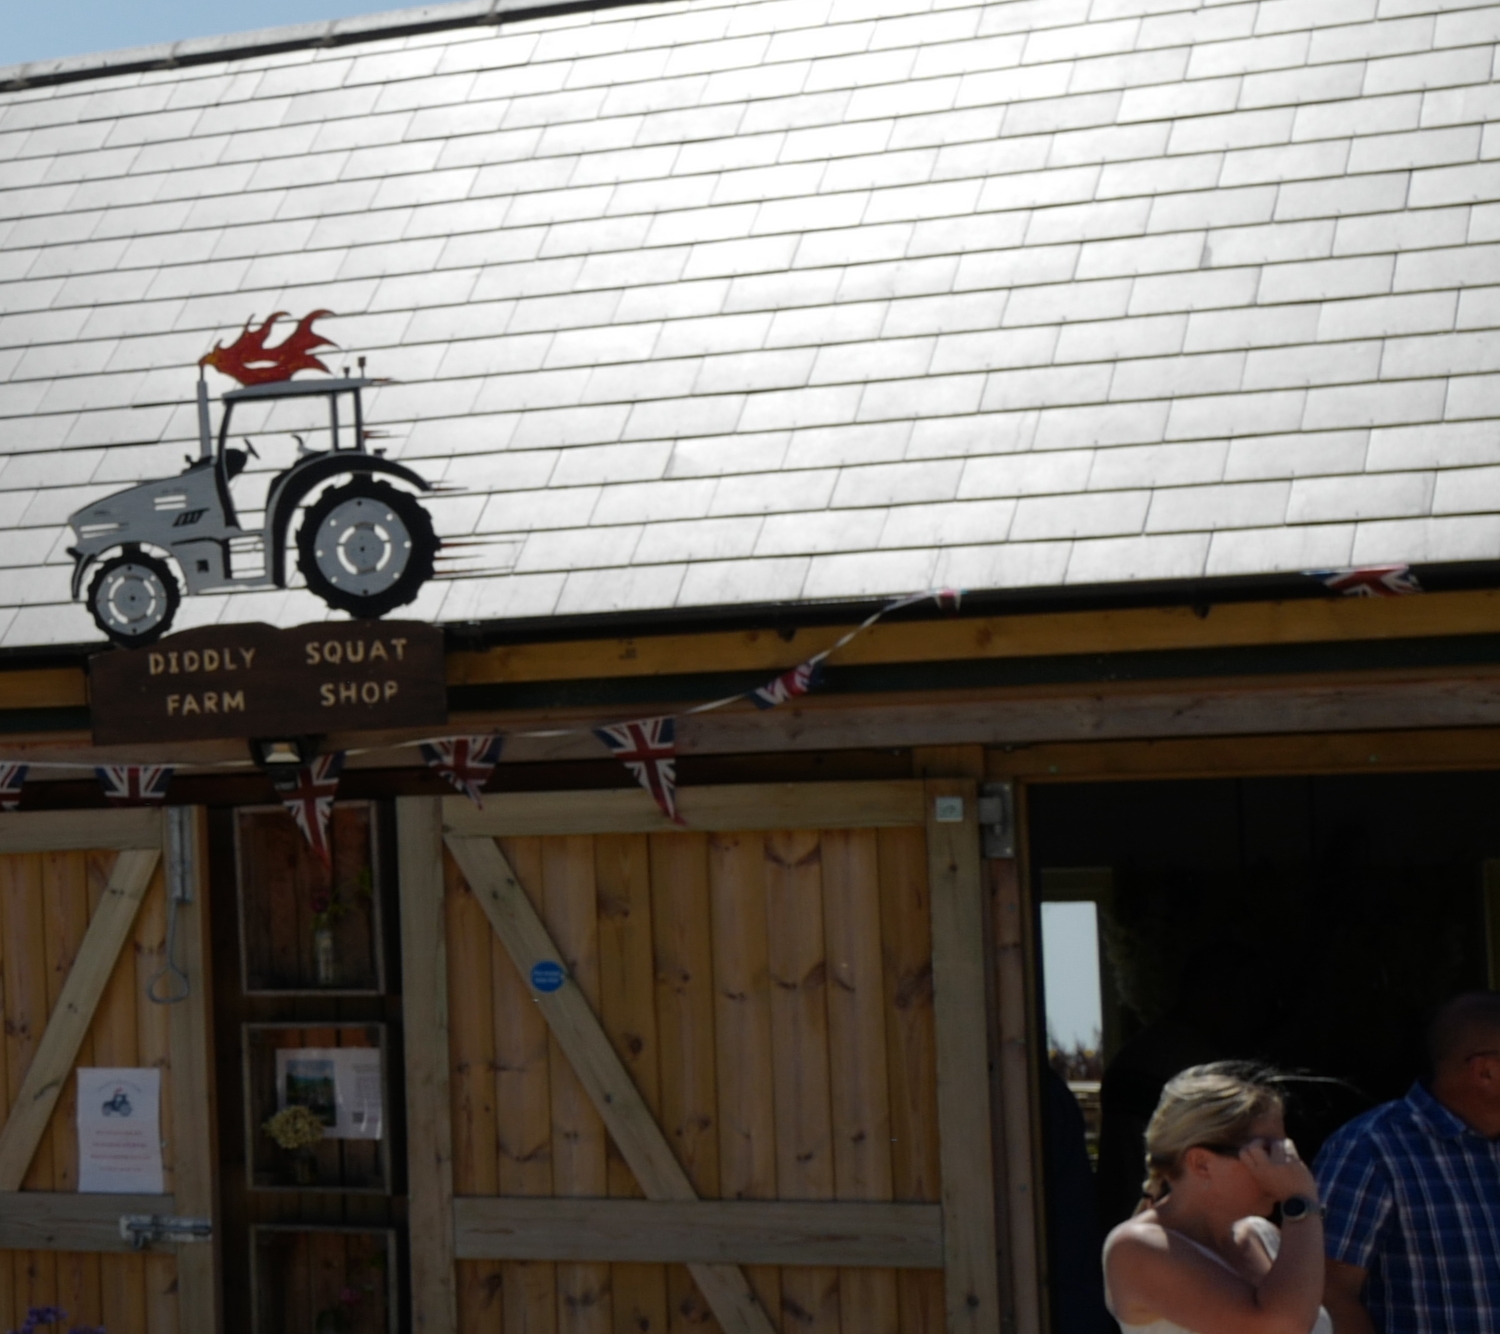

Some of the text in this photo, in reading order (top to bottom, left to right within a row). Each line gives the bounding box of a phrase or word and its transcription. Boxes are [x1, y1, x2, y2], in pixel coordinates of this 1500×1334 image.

[149, 638, 407, 675] DIDDLY SQUAT
[166, 680, 399, 716] FARM SHOP
